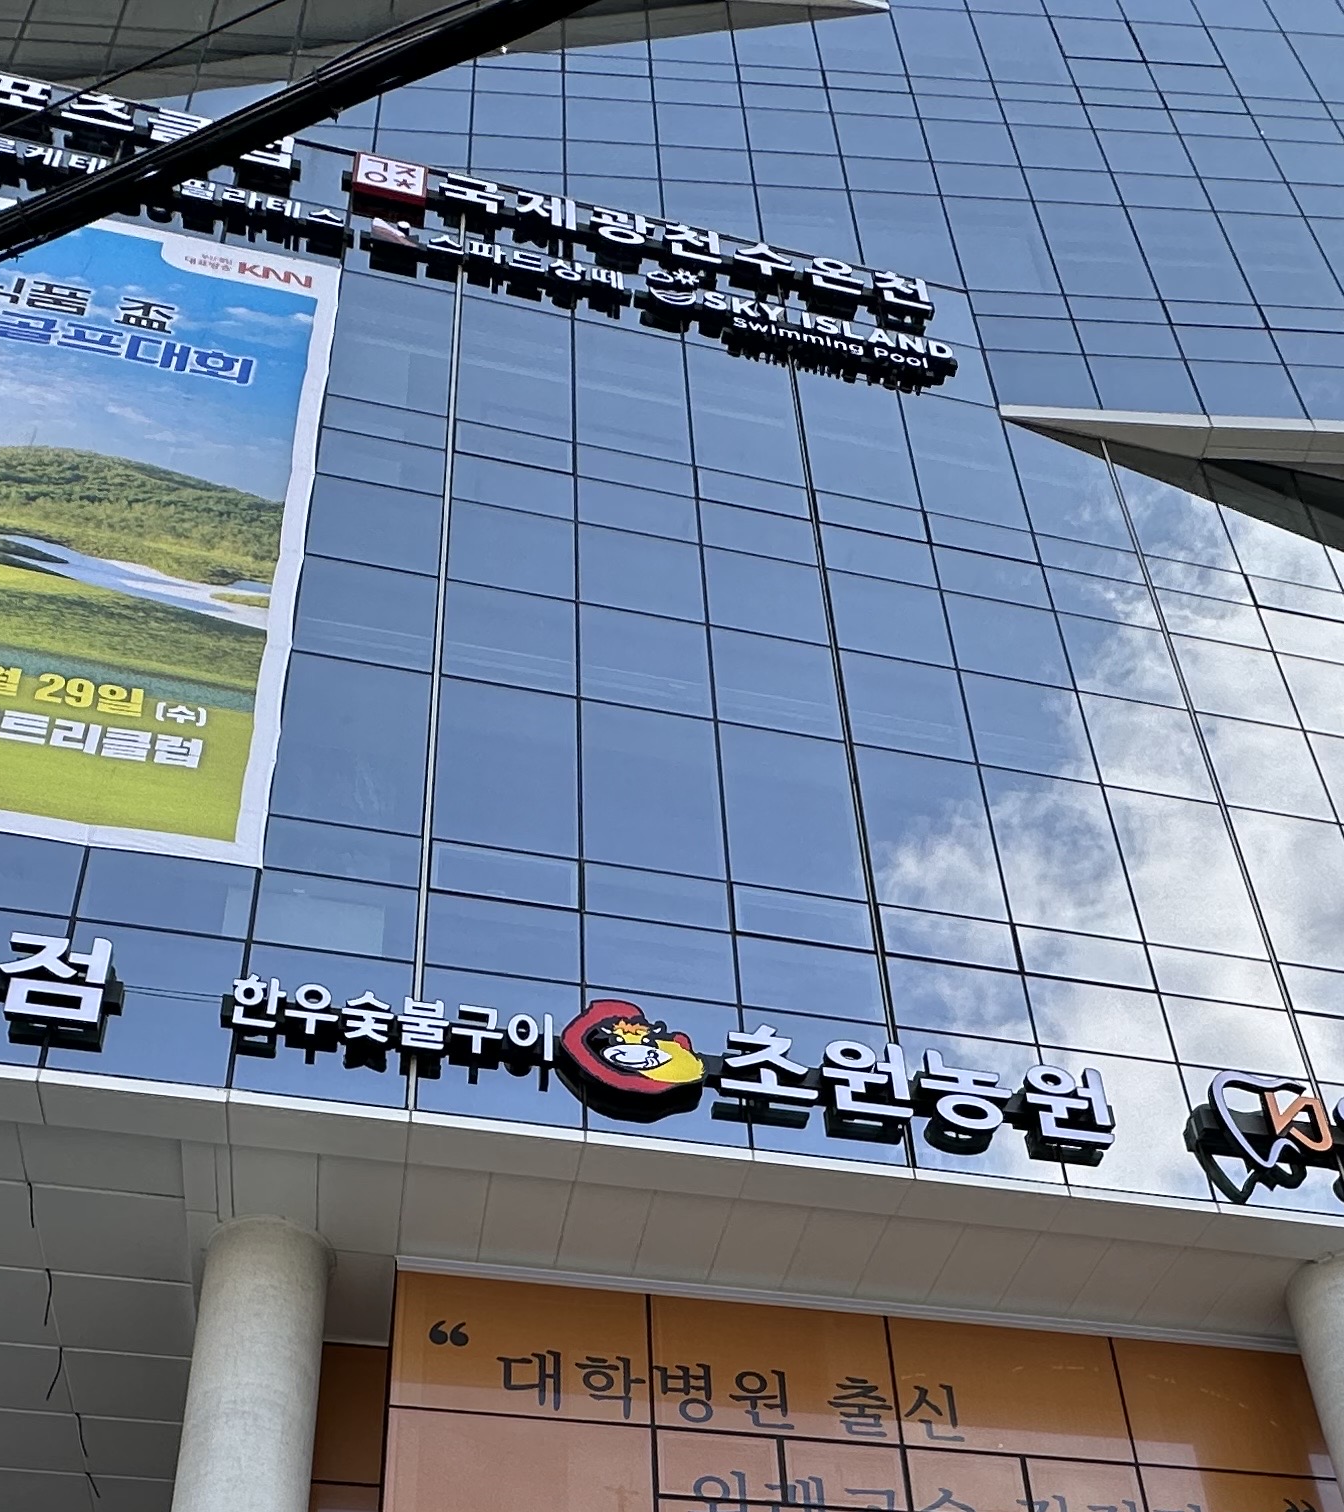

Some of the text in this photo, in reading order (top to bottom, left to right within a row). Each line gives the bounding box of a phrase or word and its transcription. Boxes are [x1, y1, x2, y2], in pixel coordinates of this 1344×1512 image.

[180, 179, 344, 226] 필라테스
[439, 174, 932, 311] 국제광천수온천
[238, 262, 312, 289] KNN
[704, 292, 953, 360] SKY ISLAND
[733, 316, 929, 369] Swimming Pool
[34, 673, 145, 718] 29일
[156, 702, 207, 727] (수)
[233, 972, 1116, 1152] 한우숯불구이 초원농원
[828, 1375, 965, 1443] 출신
